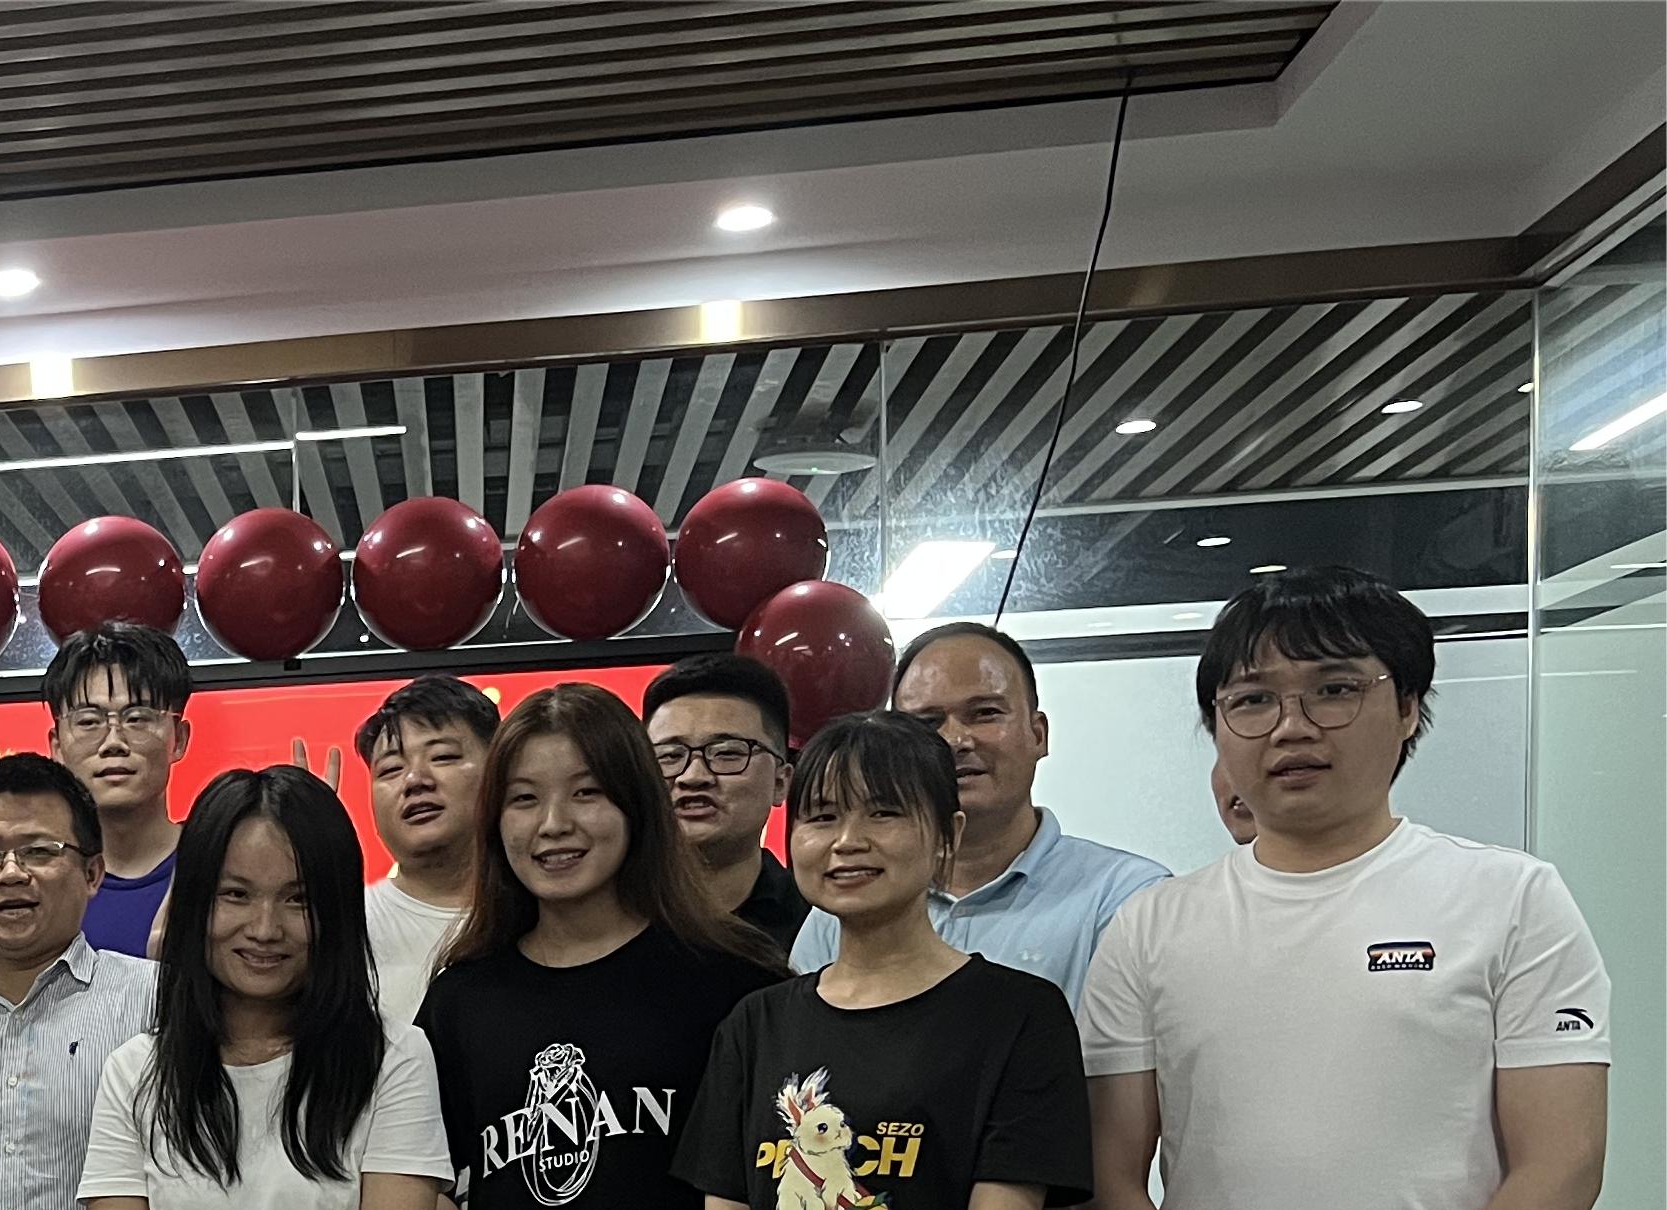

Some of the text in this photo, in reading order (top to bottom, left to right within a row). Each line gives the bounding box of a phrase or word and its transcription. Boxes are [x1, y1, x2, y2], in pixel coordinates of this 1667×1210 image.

[1376, 950, 1425, 964] ANTA
[1555, 1020, 1581, 1031] ANTA
[480, 1086, 677, 1179] RENAN
[876, 1121, 925, 1137] SEZO
[538, 1149, 590, 1173] STUDIO
